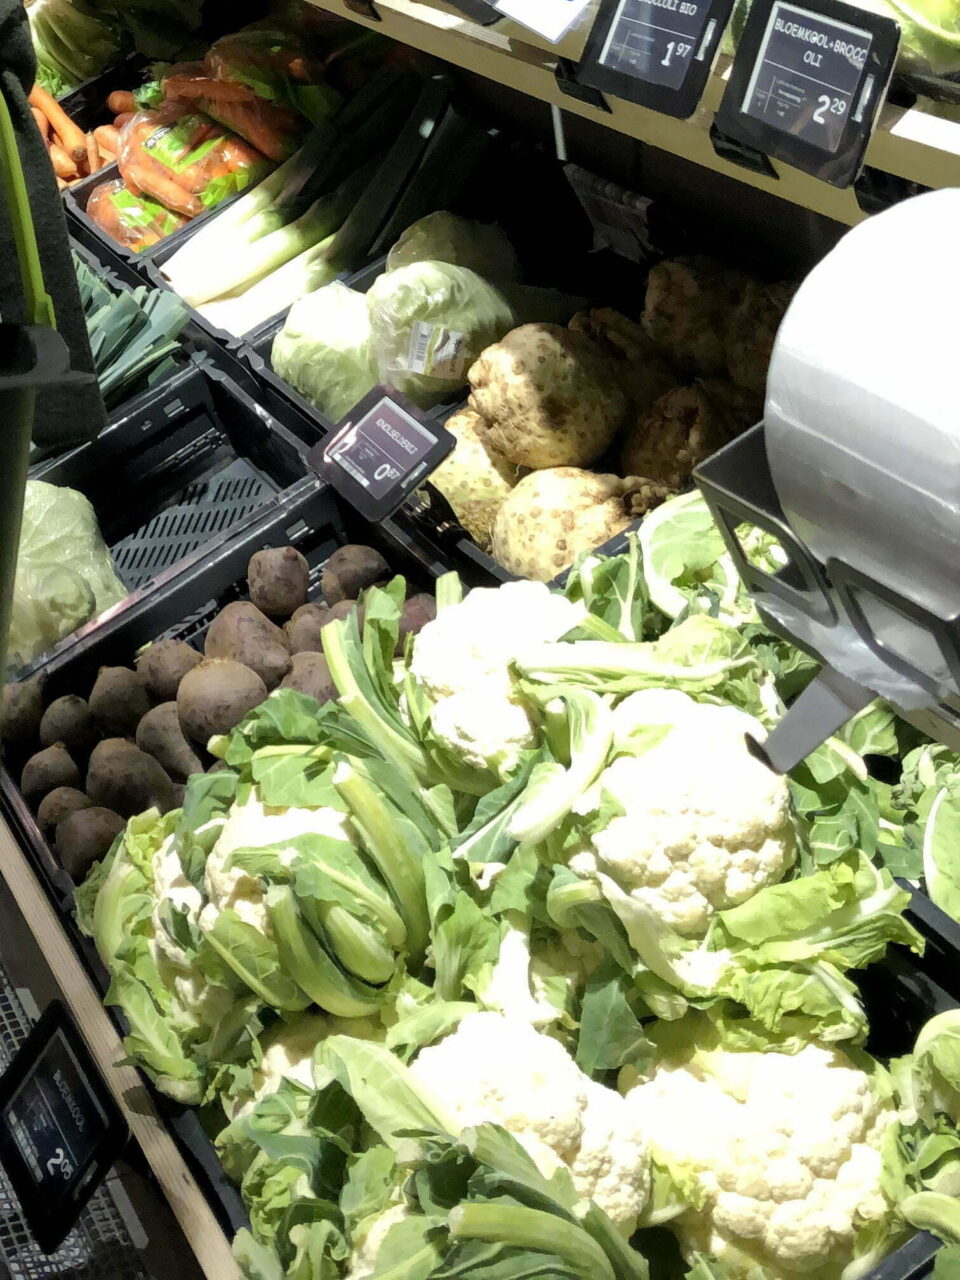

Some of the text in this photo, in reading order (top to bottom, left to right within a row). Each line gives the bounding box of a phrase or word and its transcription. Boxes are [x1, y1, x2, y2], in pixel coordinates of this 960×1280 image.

[679, 2, 698, 16] BIO
[803, 50, 823, 68] OLI
[53, 1069, 85, 1133] BLOEMKOOL
